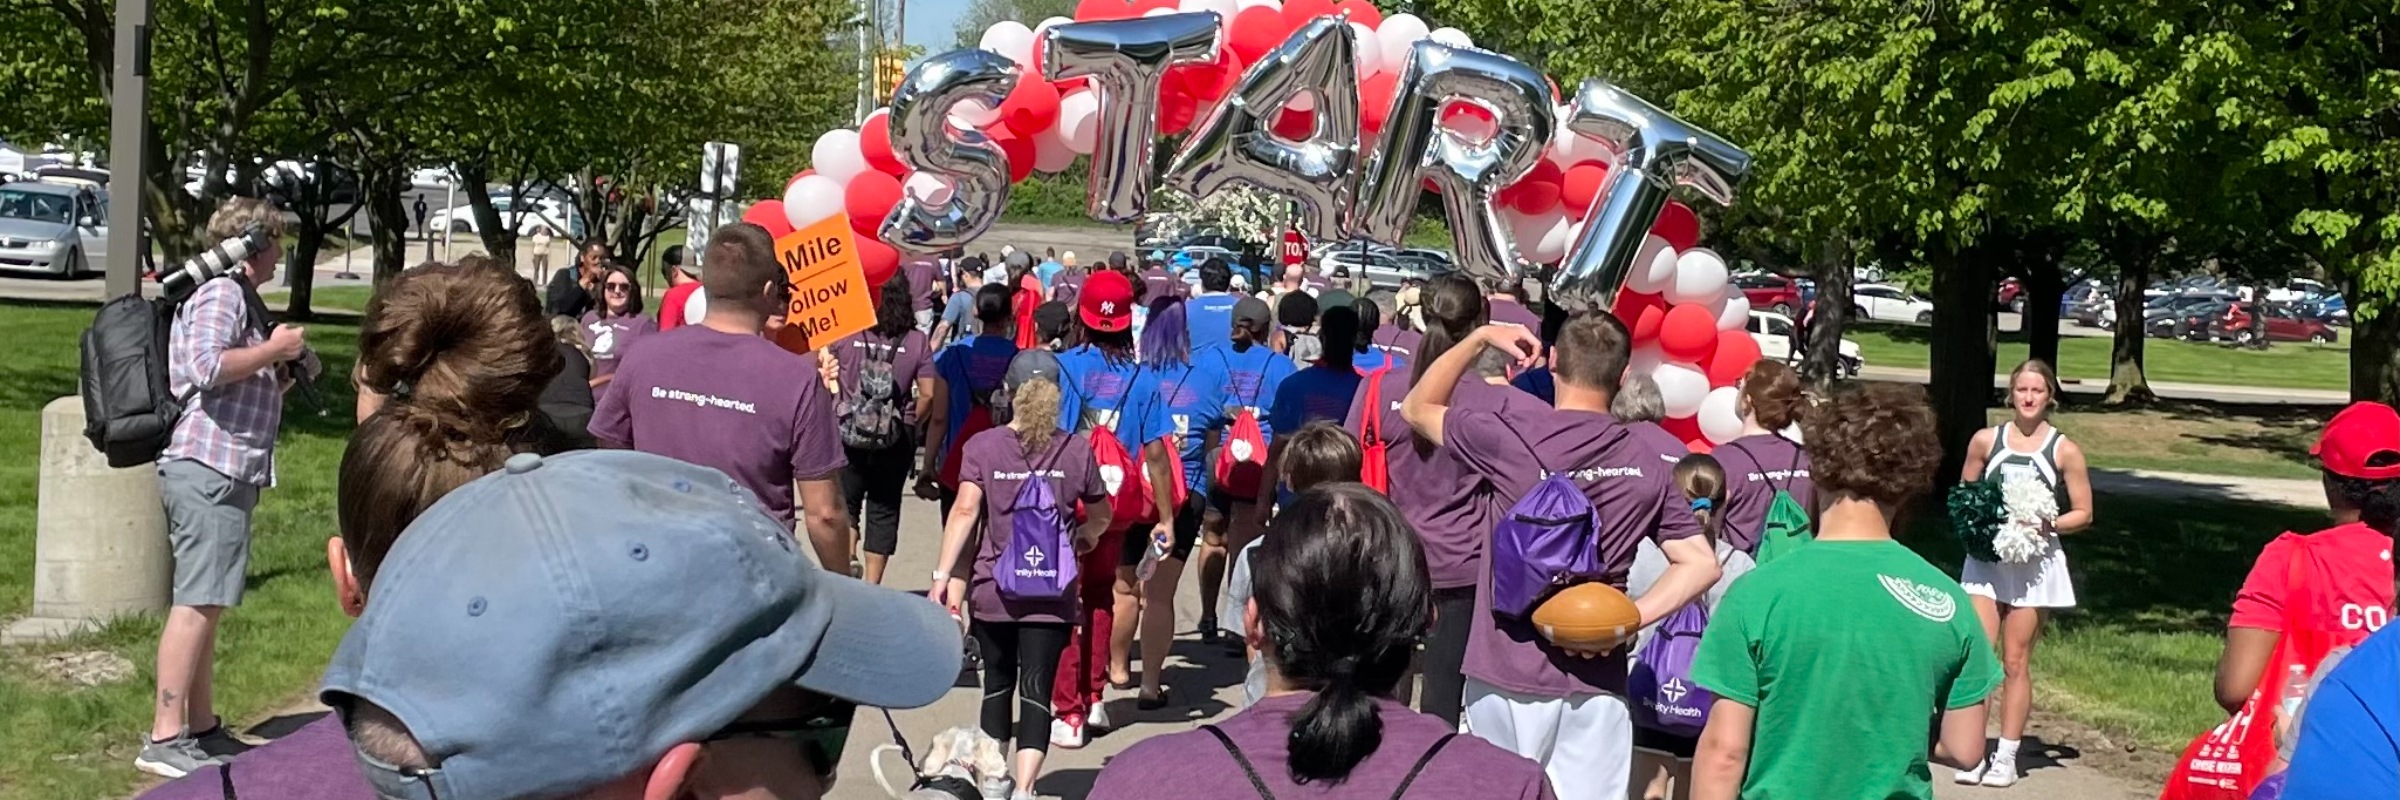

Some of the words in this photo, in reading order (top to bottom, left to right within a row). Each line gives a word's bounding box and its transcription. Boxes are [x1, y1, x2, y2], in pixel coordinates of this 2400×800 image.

[877, 9, 1752, 311] START
[785, 236, 842, 274] Mile
[1284, 241, 1309, 256] TOP
[791, 279, 847, 315] ollow
[799, 307, 839, 339] Me!
[651, 386, 667, 398] Be
[668, 389, 756, 414] strong-hearted.
[1669, 703, 1702, 718] Health
